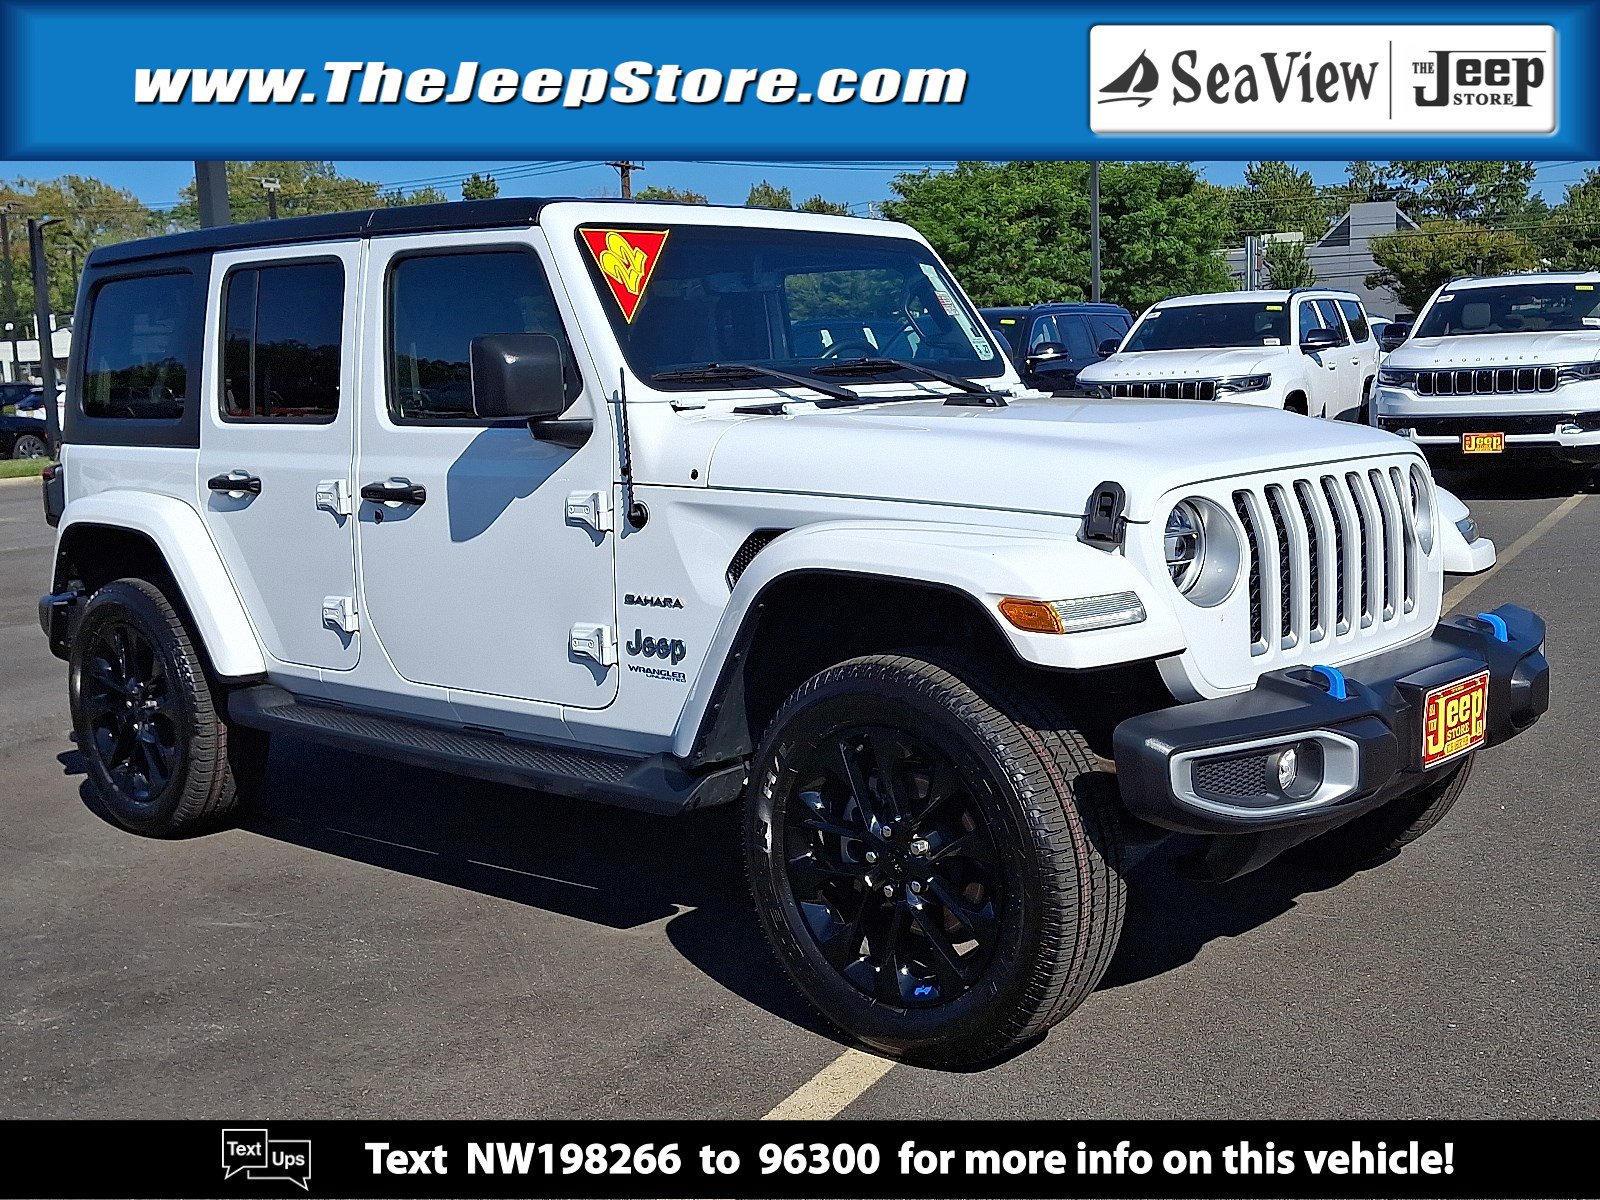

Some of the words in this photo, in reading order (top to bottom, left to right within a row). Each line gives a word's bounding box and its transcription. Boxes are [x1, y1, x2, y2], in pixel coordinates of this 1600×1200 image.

[1465, 436, 1501, 451] Jeep
[624, 594, 684, 609] SAHARA
[626, 629, 687, 666] Jeep
[628, 664, 686, 679] WRANGLER
[646, 674, 687, 683] UNLIMITED
[1427, 688, 1483, 755] Jeep
[1447, 722, 1470, 741] STORE
